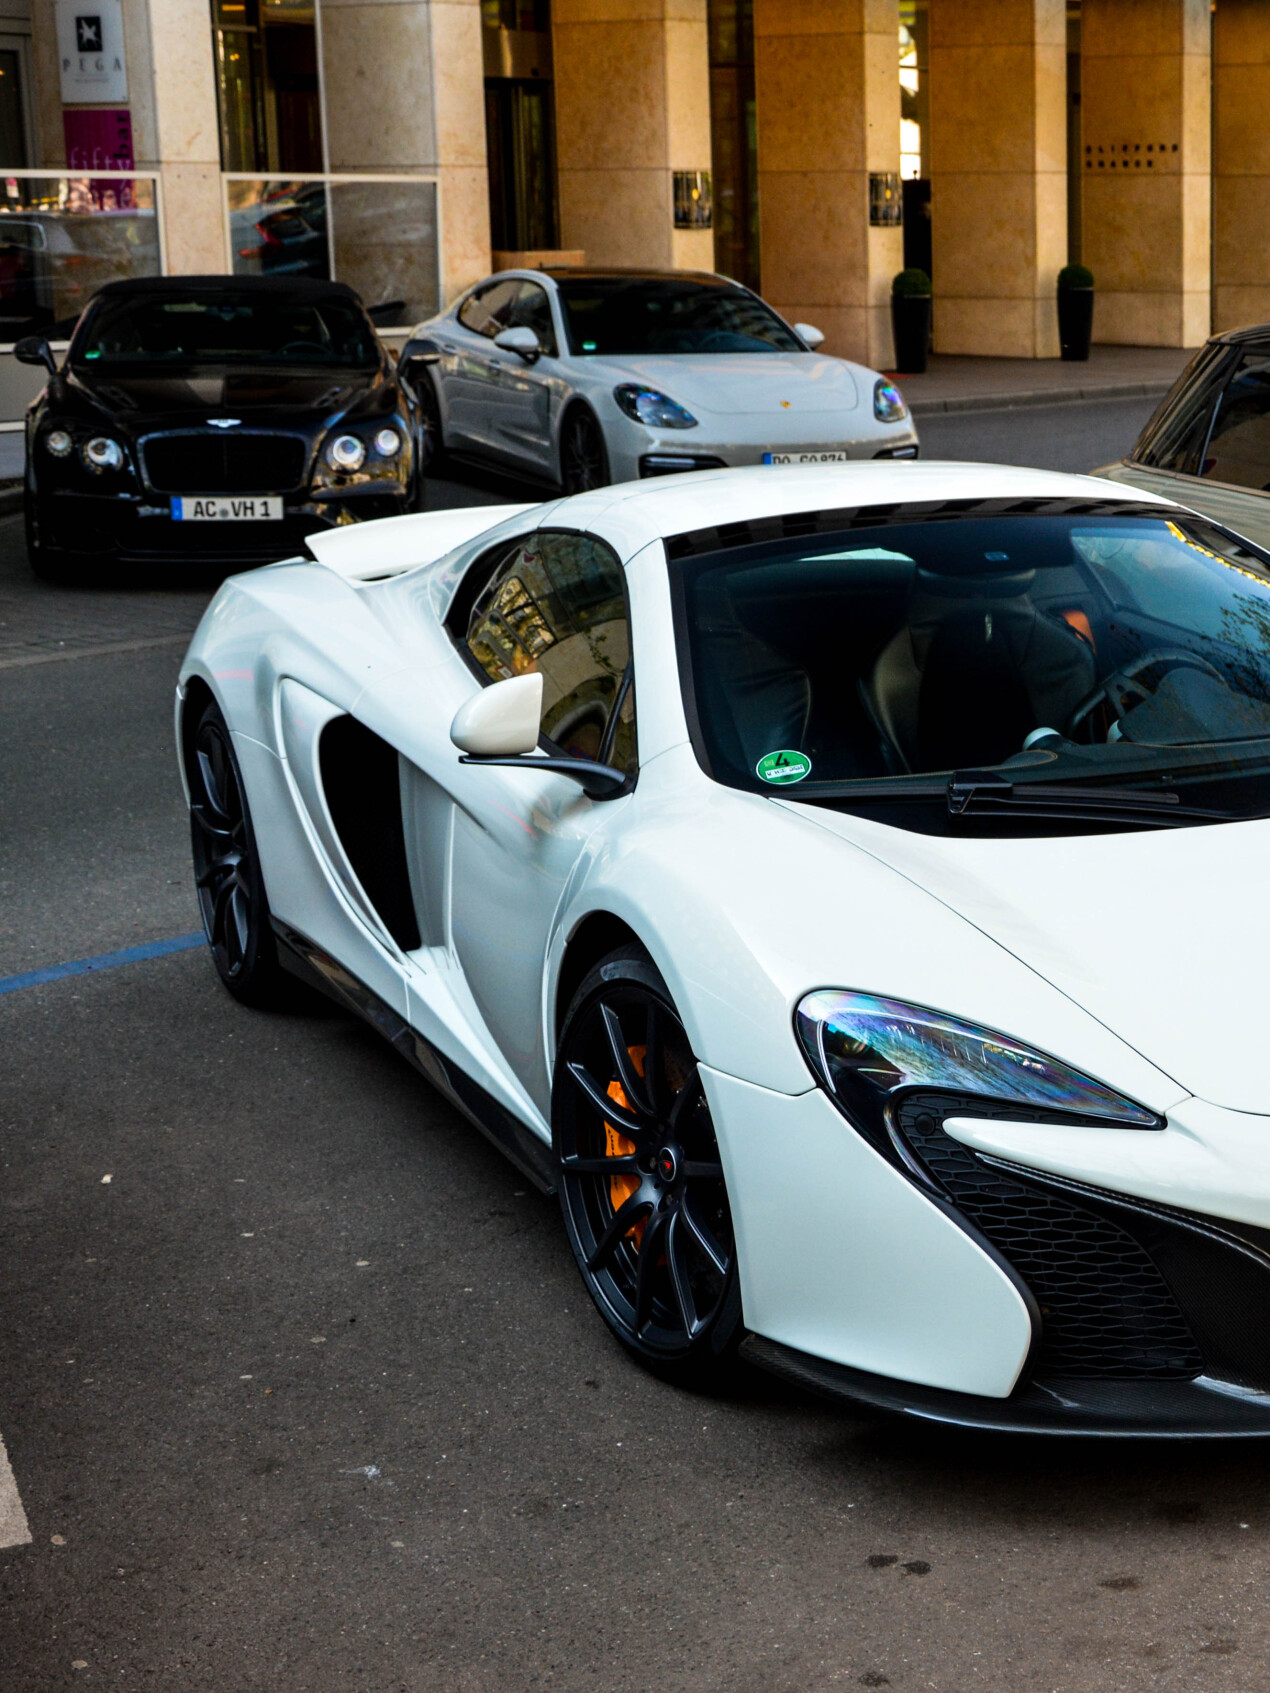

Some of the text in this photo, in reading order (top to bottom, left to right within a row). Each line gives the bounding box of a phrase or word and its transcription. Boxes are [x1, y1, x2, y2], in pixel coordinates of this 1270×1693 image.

[193, 501, 271, 517] AC VH 1
[776, 753, 789, 766] 4
